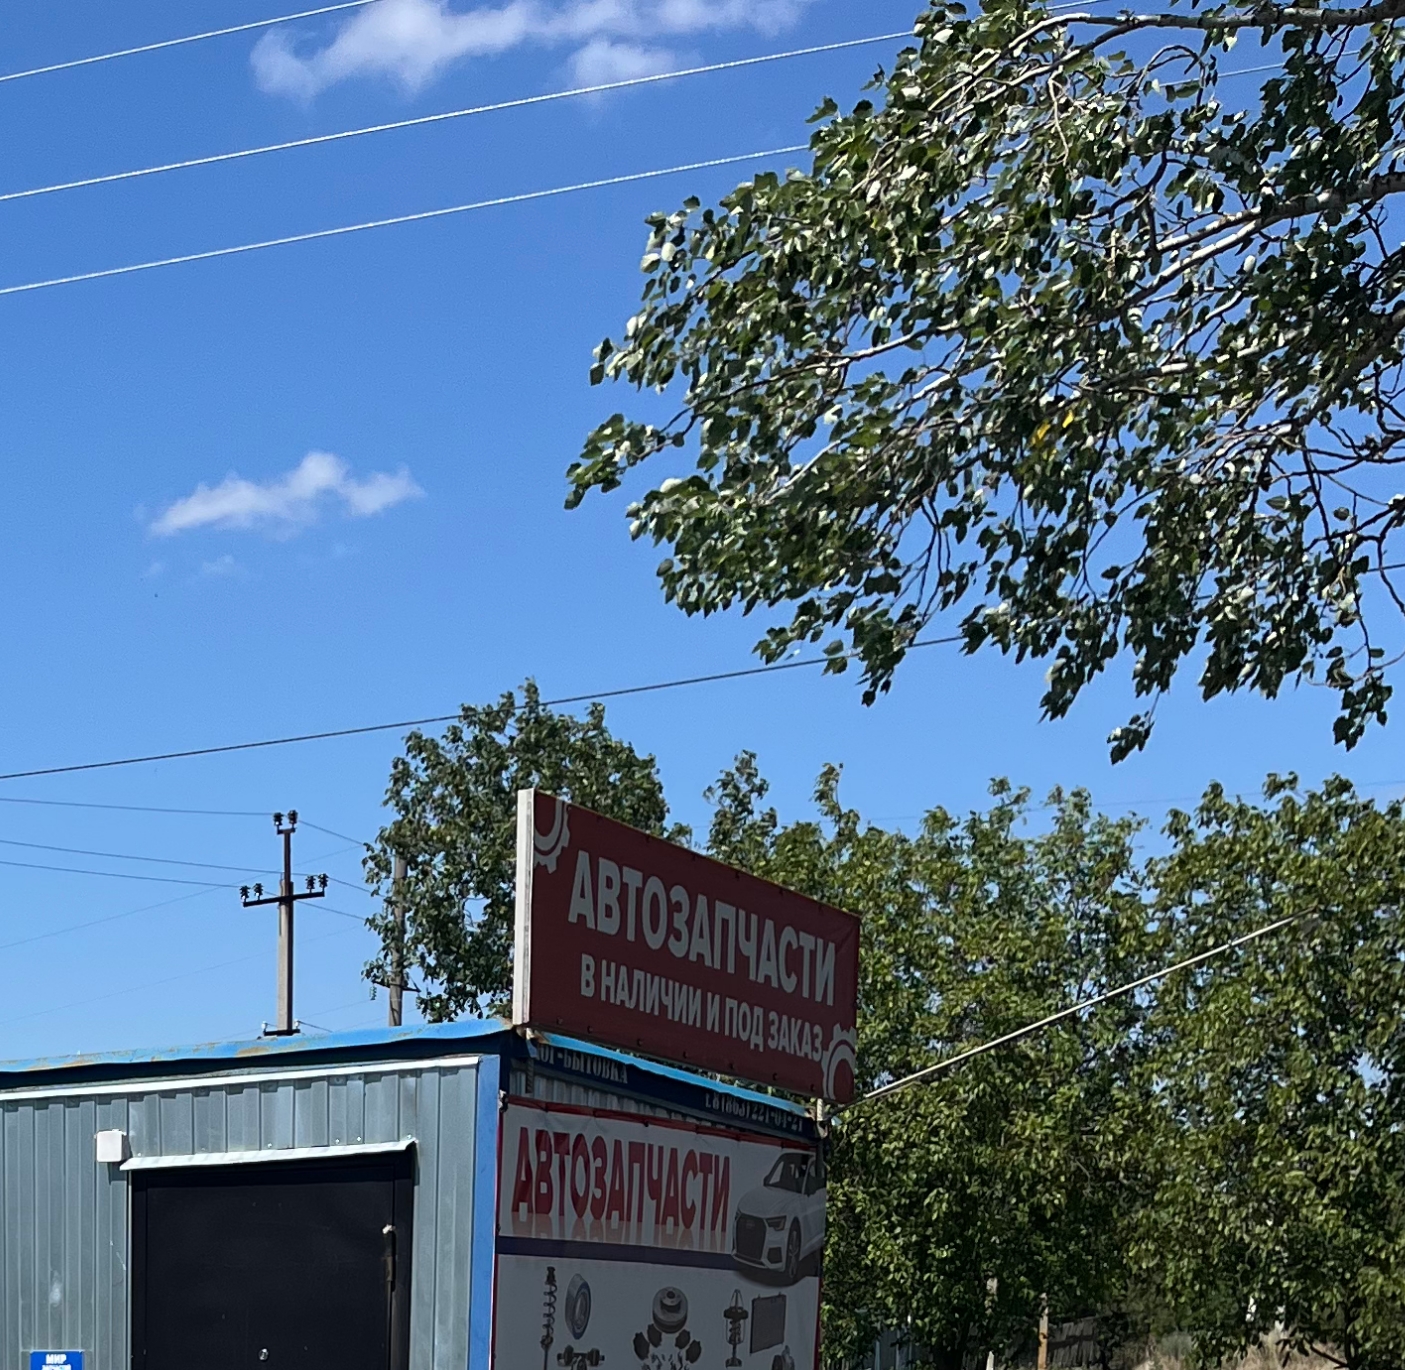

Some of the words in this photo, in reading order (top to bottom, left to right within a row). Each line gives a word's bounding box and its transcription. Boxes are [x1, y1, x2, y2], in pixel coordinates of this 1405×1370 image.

[568, 850, 837, 1006] АВТОЗАПЧАСТИ
[581, 953, 595, 998] В
[601, 959, 702, 1029] НАЛИЧИИ
[707, 993, 720, 1035] И
[725, 999, 765, 1053] ПОД
[768, 1011, 824, 1063] ЗАКАЗ
[512, 1126, 731, 1234] АВТОЗАПЧАСТИ
